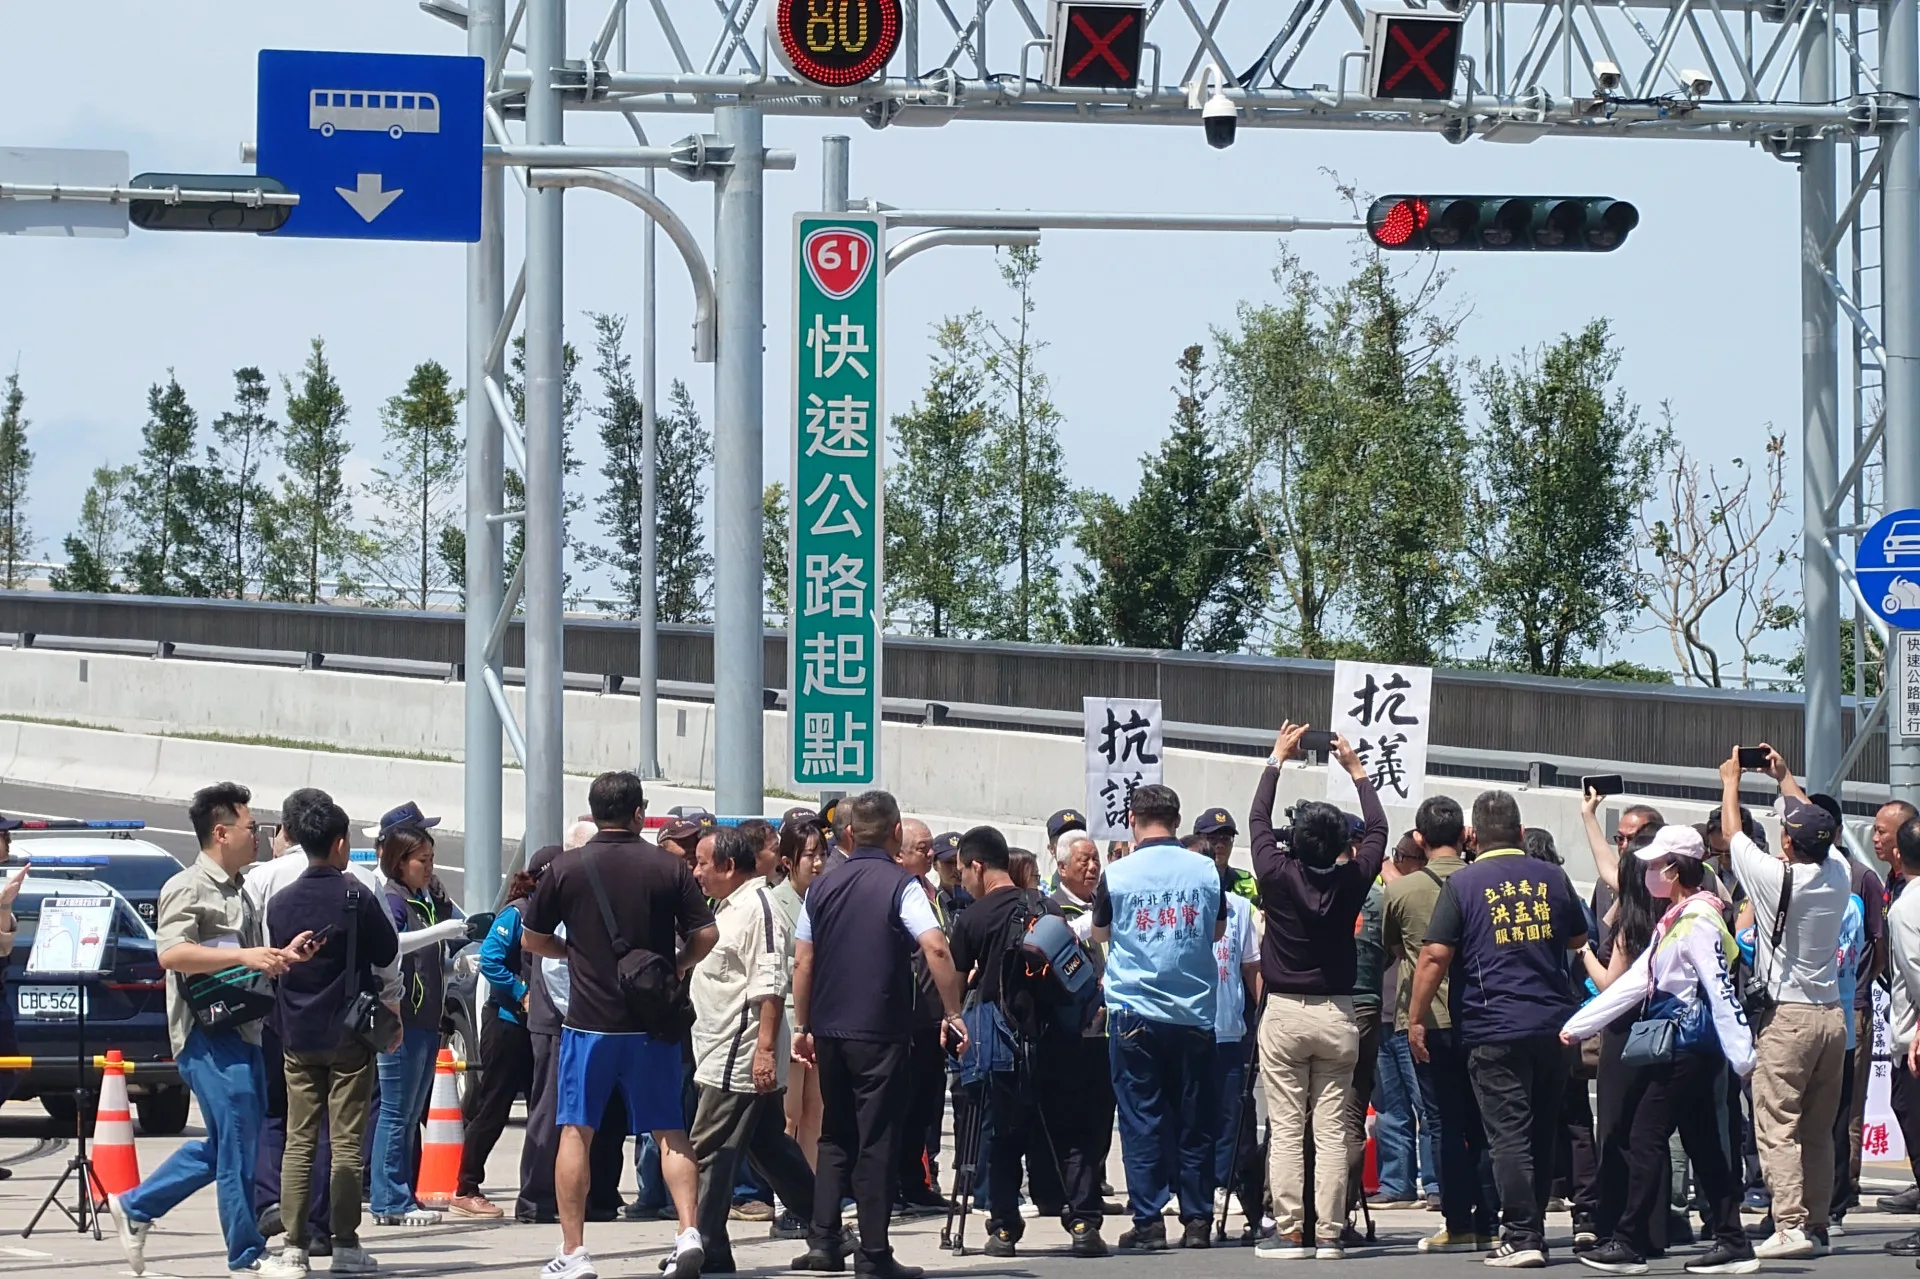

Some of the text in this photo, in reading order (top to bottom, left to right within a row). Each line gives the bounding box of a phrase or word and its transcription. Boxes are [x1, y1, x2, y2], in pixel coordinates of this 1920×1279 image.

[807, 0, 867, 52] 80
[817, 240, 858, 271] 61
[802, 314, 869, 776] 快速公路起點
[1346, 672, 1418, 799] 抗議
[1132, 889, 1200, 907] 新北市議員
[1484, 879, 1548, 904] 立法委員
[1136, 904, 1200, 931] 蔡錦賢
[1490, 900, 1551, 925] 洪孟楷
[1494, 923, 1554, 945] 服務團隊
